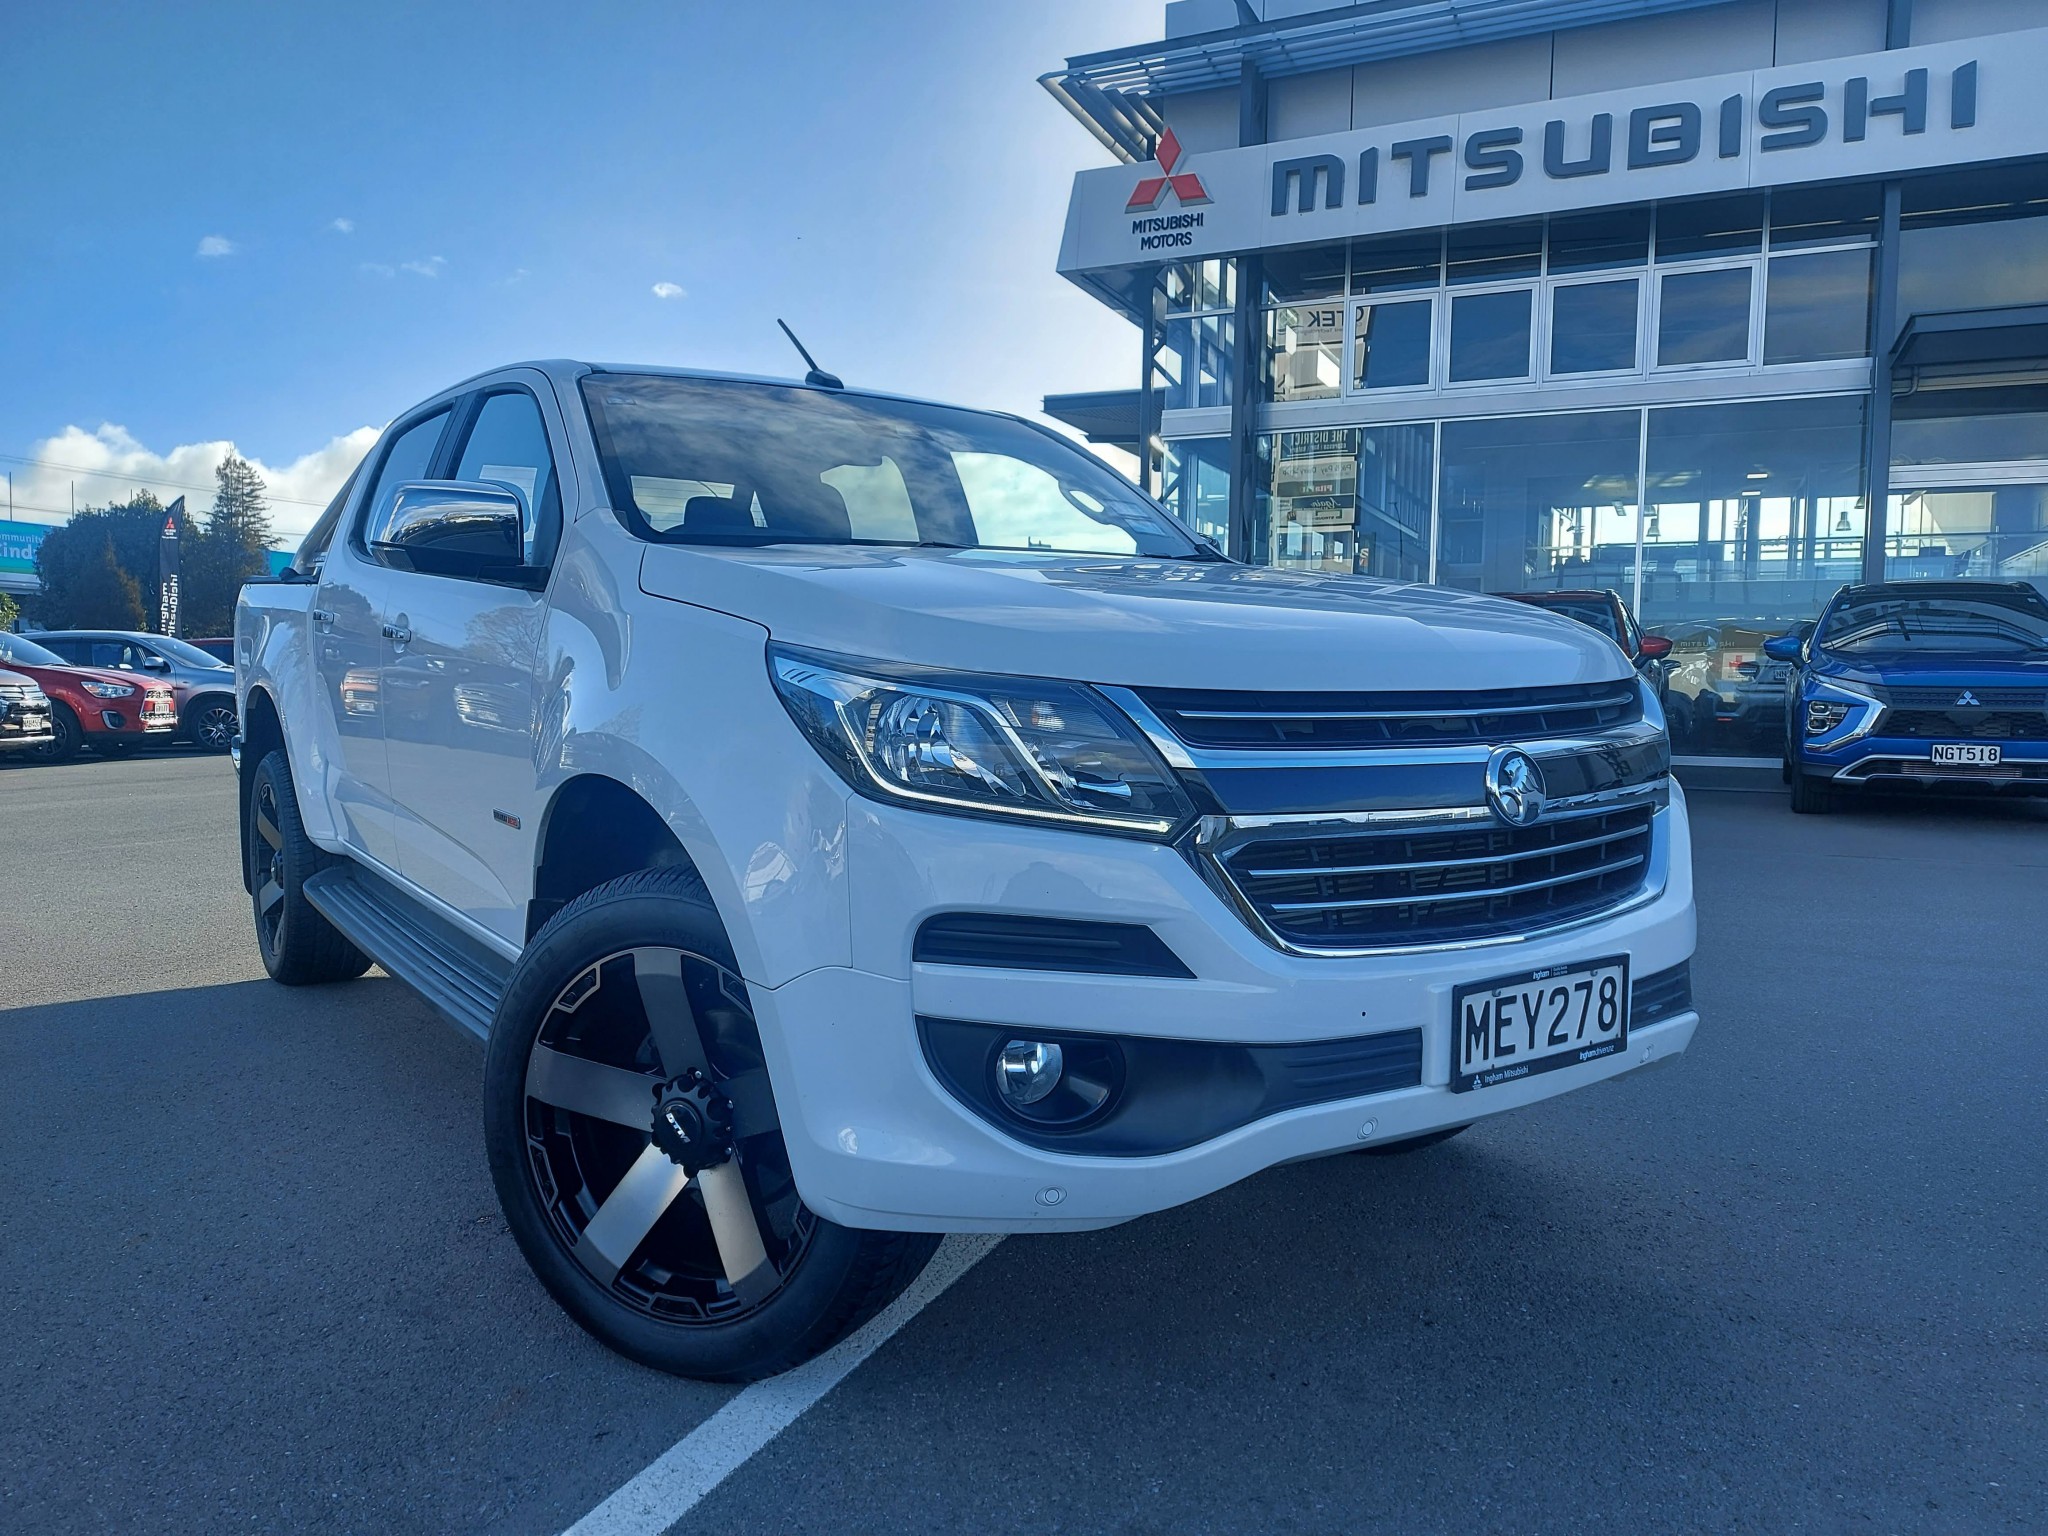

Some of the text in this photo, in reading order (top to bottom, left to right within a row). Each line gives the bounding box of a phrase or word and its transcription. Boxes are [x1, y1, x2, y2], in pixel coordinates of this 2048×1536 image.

[1271, 59, 1977, 216] MITSUBISHI
[1132, 212, 1204, 234] MITSUBISHI
[1140, 231, 1193, 251] MOTORS
[1933, 746, 1998, 762] NGT518
[1465, 976, 1617, 1064] MEY278
[1484, 1065, 1529, 1084] Ingham Mitsubishi
